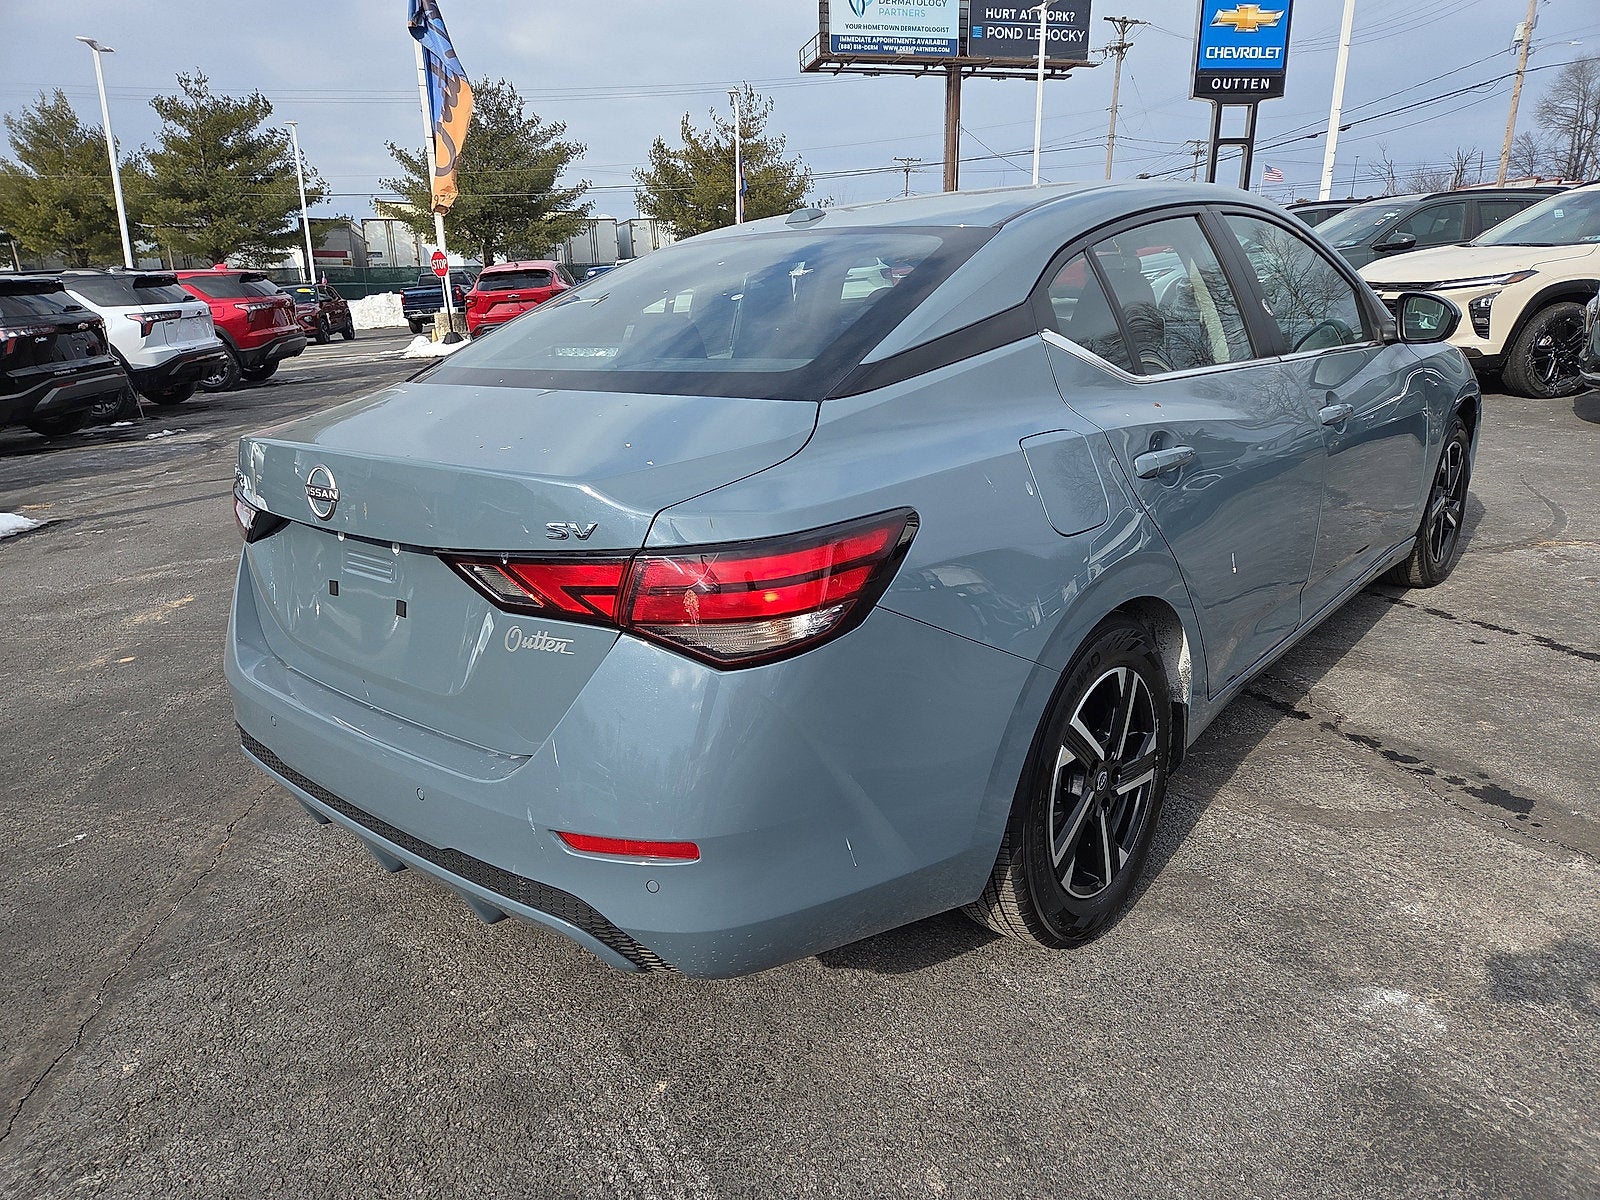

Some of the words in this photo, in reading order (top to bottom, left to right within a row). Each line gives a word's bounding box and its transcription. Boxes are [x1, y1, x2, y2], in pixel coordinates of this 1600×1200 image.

[878, 8, 926, 17] PARTNERS
[985, 8, 1017, 19] HURT
[1019, 9, 1032, 20] AT
[901, 25, 949, 33] DERMATOLOGIST
[986, 27, 1023, 39] POND
[1027, 28, 1085, 42] LEHOCKY
[1206, 46, 1282, 59] CHEVROLET
[1211, 78, 1270, 89] OUTTEN
[432, 258, 447, 270] STOP
[545, 521, 599, 541] SV
[504, 625, 575, 655] Outten
